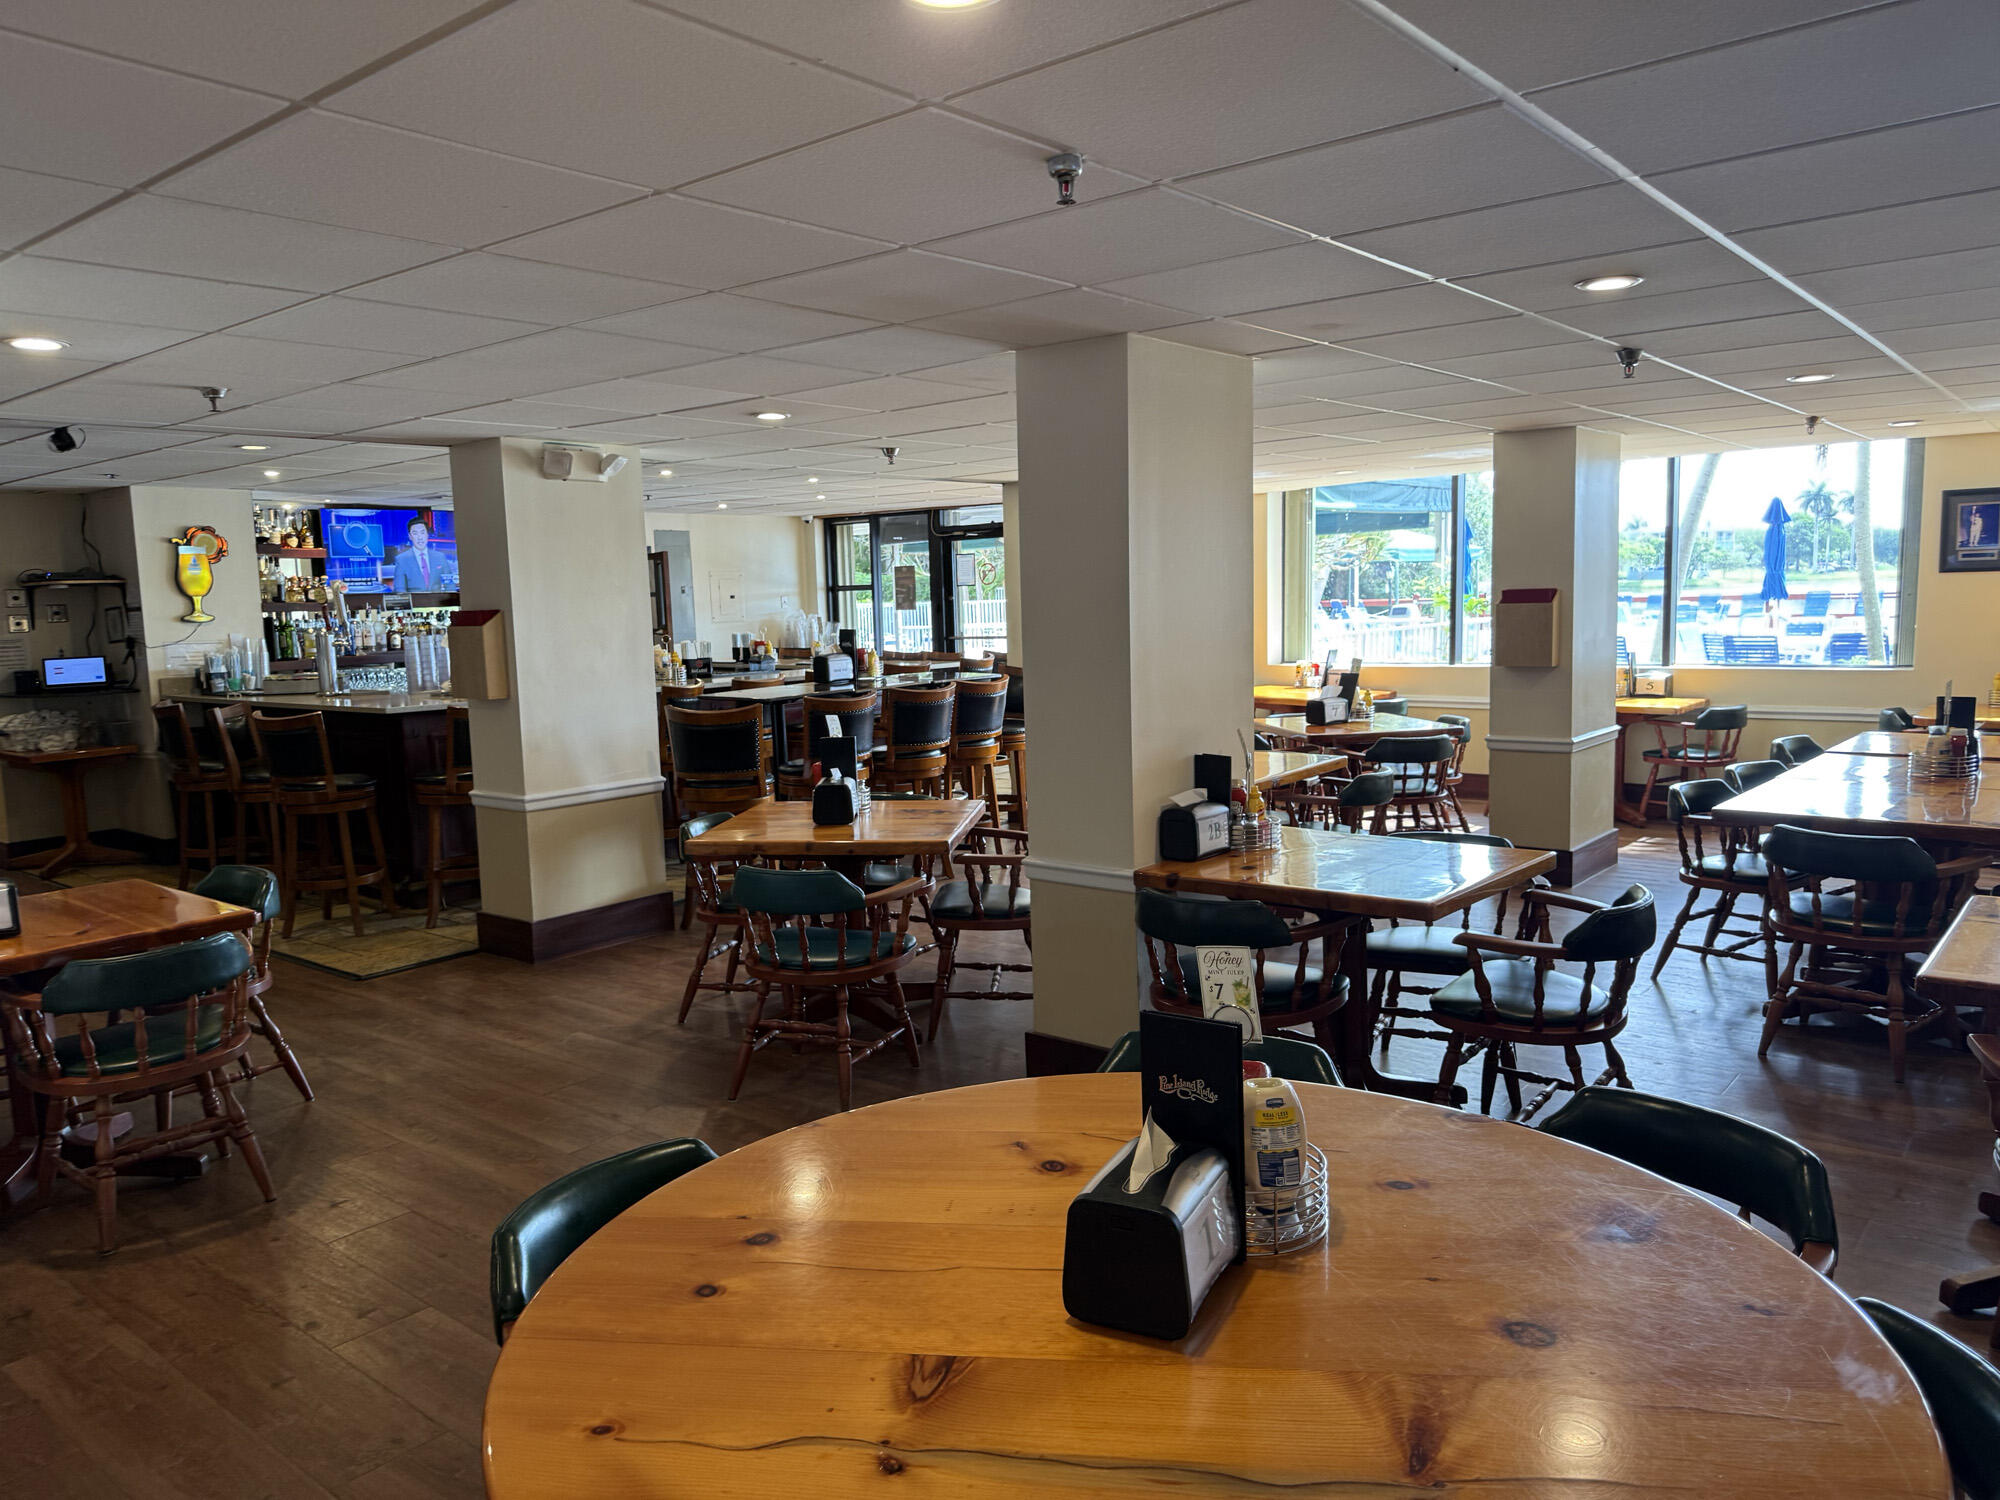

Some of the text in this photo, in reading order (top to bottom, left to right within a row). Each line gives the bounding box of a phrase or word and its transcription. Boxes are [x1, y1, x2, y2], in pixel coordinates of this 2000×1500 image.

[1646, 681, 1654, 690] 5
[1332, 707, 1339, 717] 7
[1208, 822, 1222, 840] 2B
[1203, 950, 1243, 971] Honey
[1209, 983, 1224, 1000] $7
[1159, 1073, 1219, 1103] Pine Island Ridge
[1199, 1215, 1221, 1271] 1
